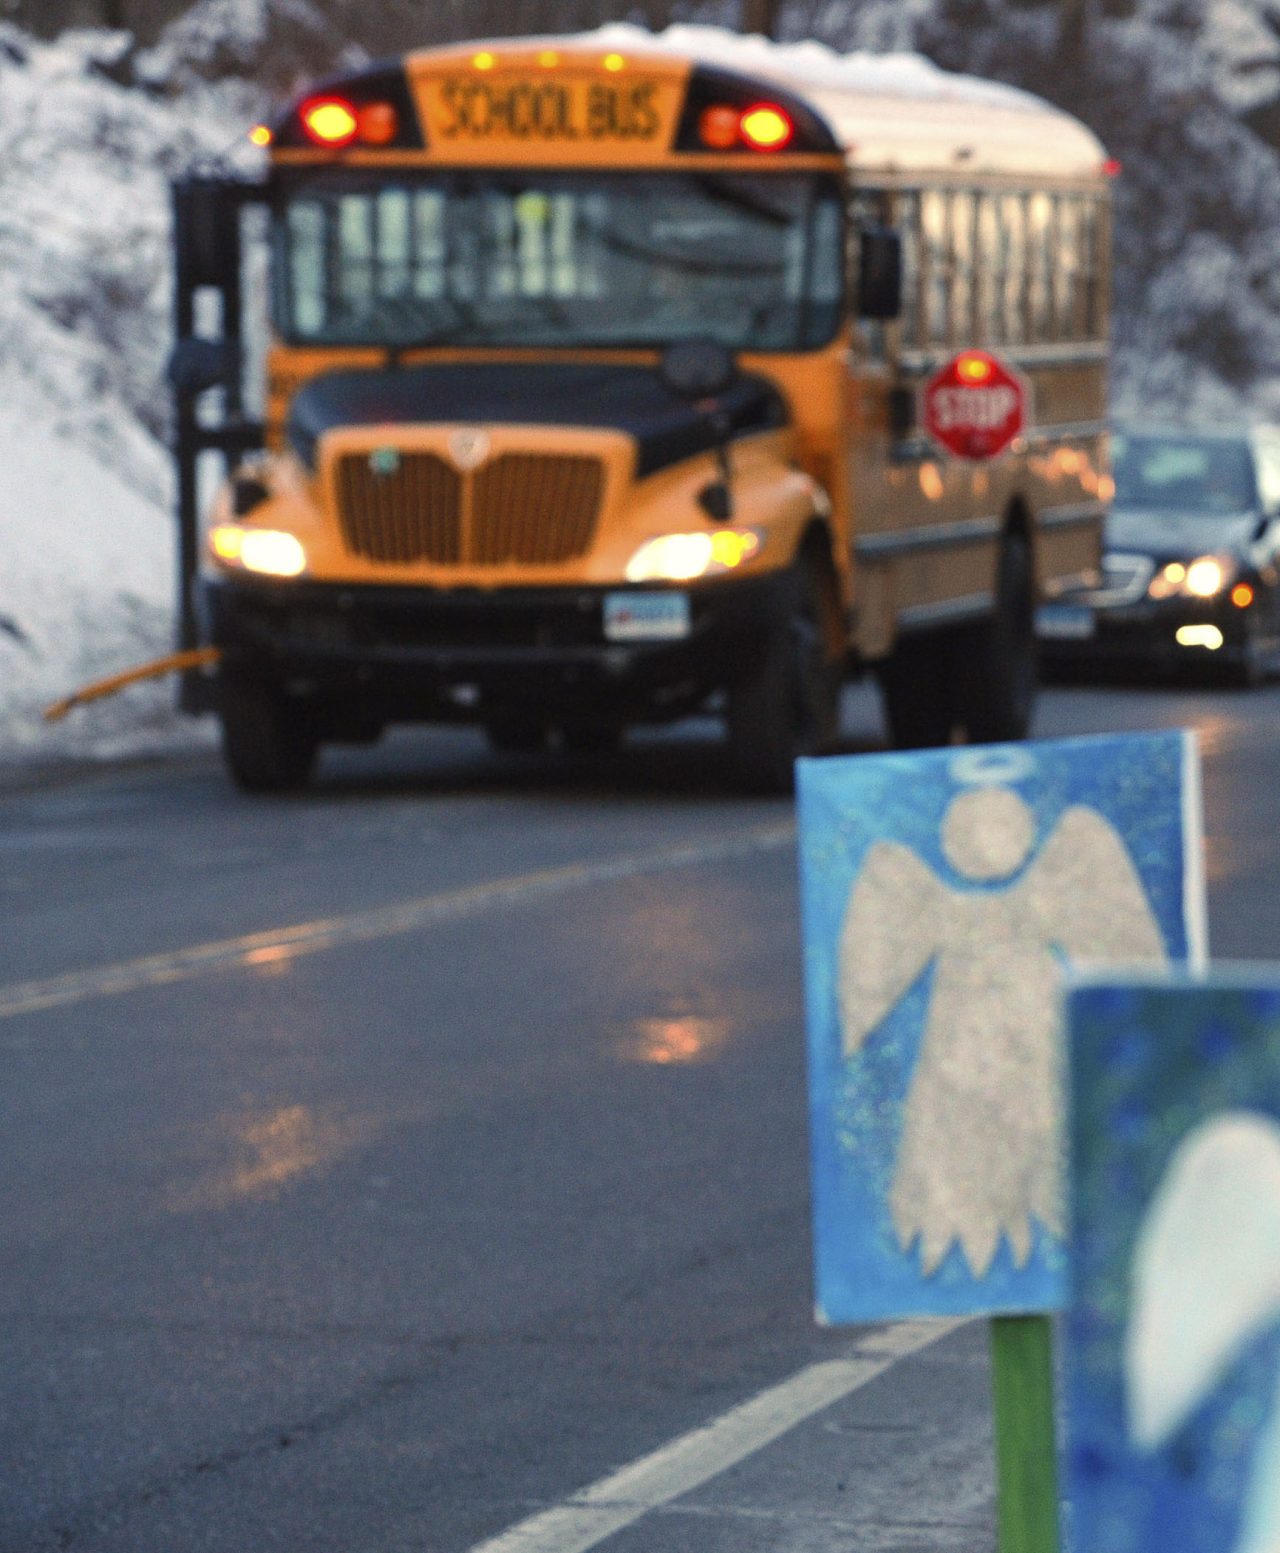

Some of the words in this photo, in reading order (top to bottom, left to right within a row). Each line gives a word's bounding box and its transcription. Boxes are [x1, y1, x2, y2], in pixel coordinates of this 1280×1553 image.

[438, 79, 580, 139] SCHOOL
[588, 80, 660, 139] BUS
[932, 385, 1017, 430] STOP
